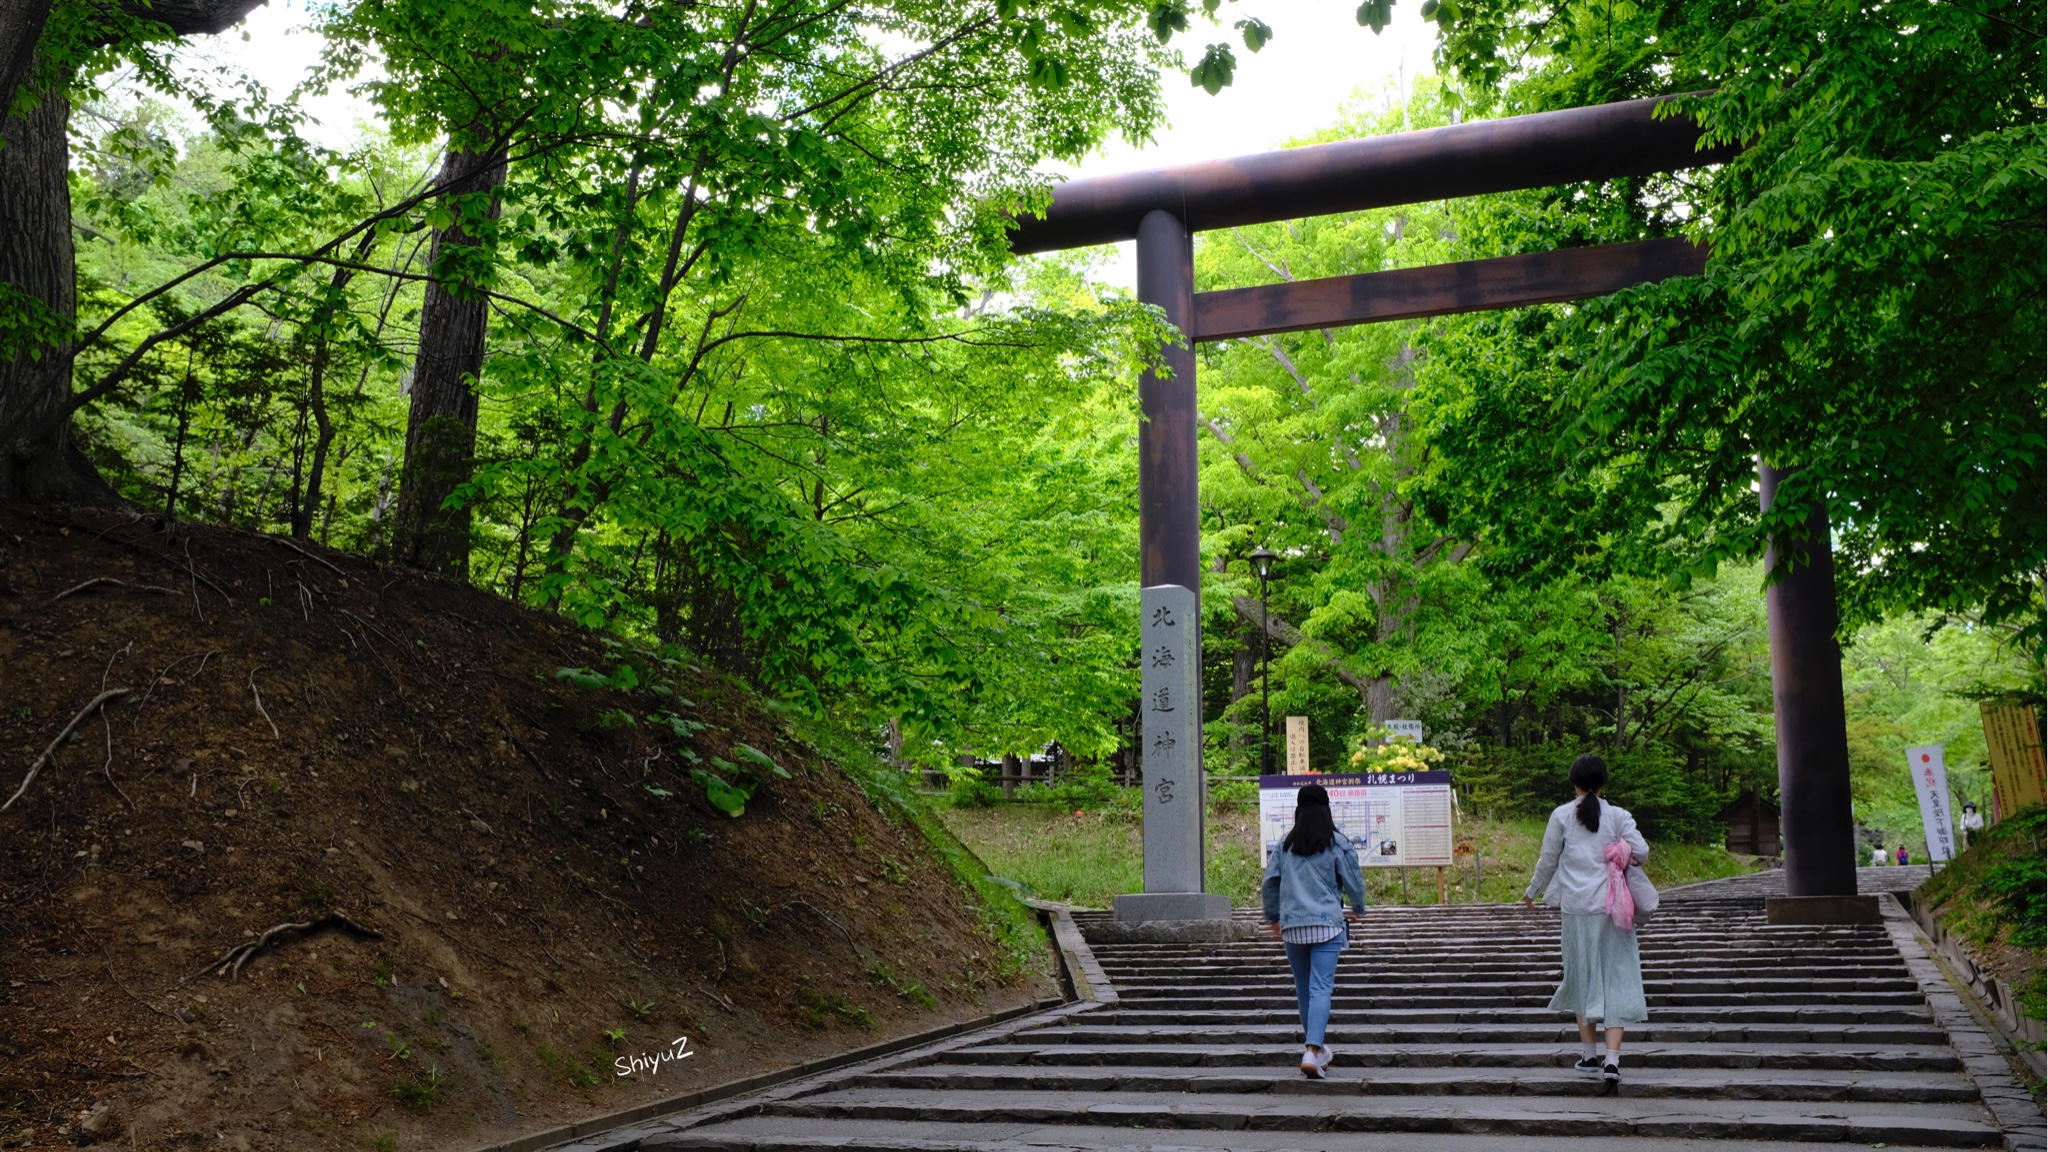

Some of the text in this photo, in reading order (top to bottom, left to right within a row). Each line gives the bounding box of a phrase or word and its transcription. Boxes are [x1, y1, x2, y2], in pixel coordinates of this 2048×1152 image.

[1151, 605, 1176, 805] 北海道神宮
[1367, 773, 1415, 784] 札幌まつり
